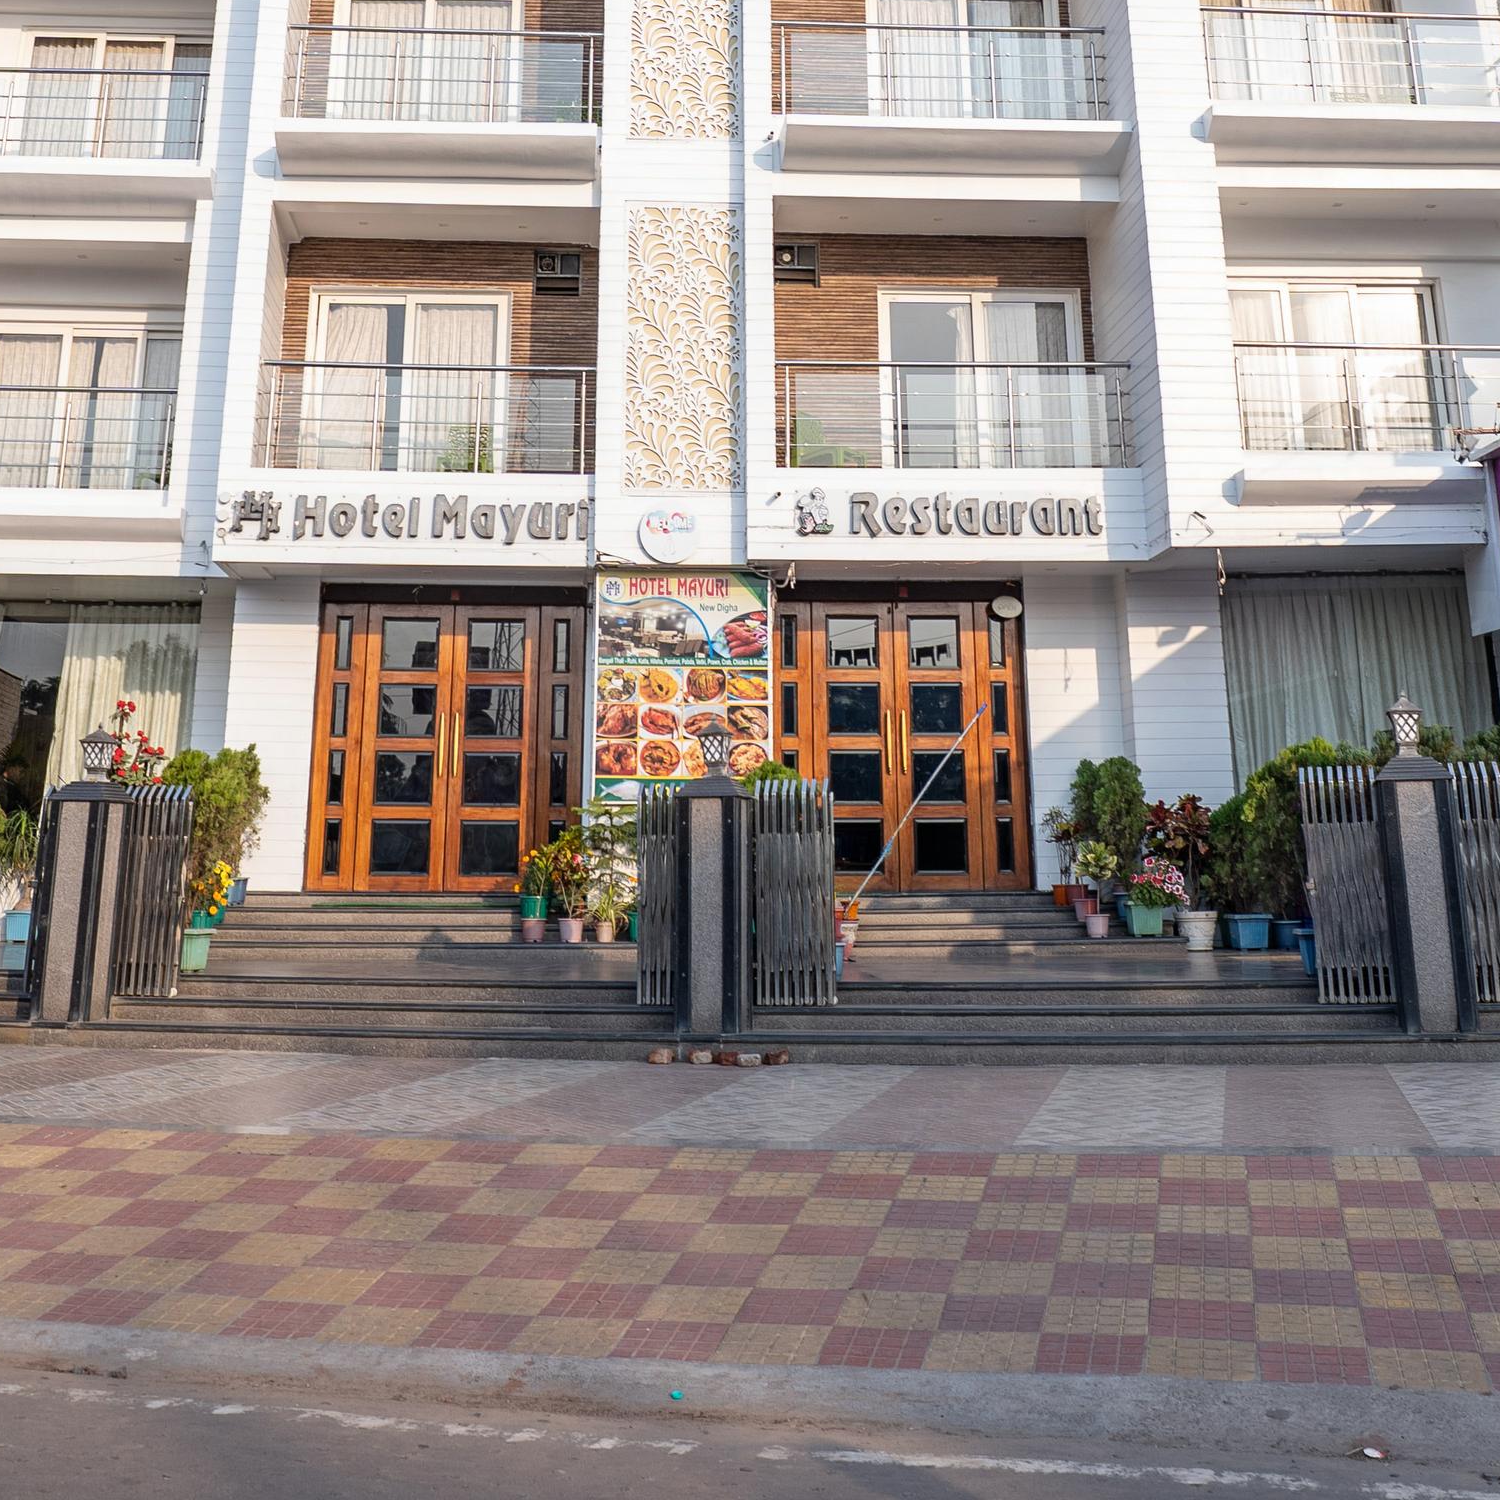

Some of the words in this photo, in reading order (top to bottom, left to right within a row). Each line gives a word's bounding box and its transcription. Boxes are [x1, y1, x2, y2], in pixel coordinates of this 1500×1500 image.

[292, 494, 421, 540] Hotel
[433, 494, 589, 546] Mayuri
[850, 492, 1104, 539] Restaurant
[629, 577, 672, 597] HOTEL
[677, 577, 729, 598] MAYURI
[700, 603, 716, 612] New
[717, 603, 738, 614] Digha
